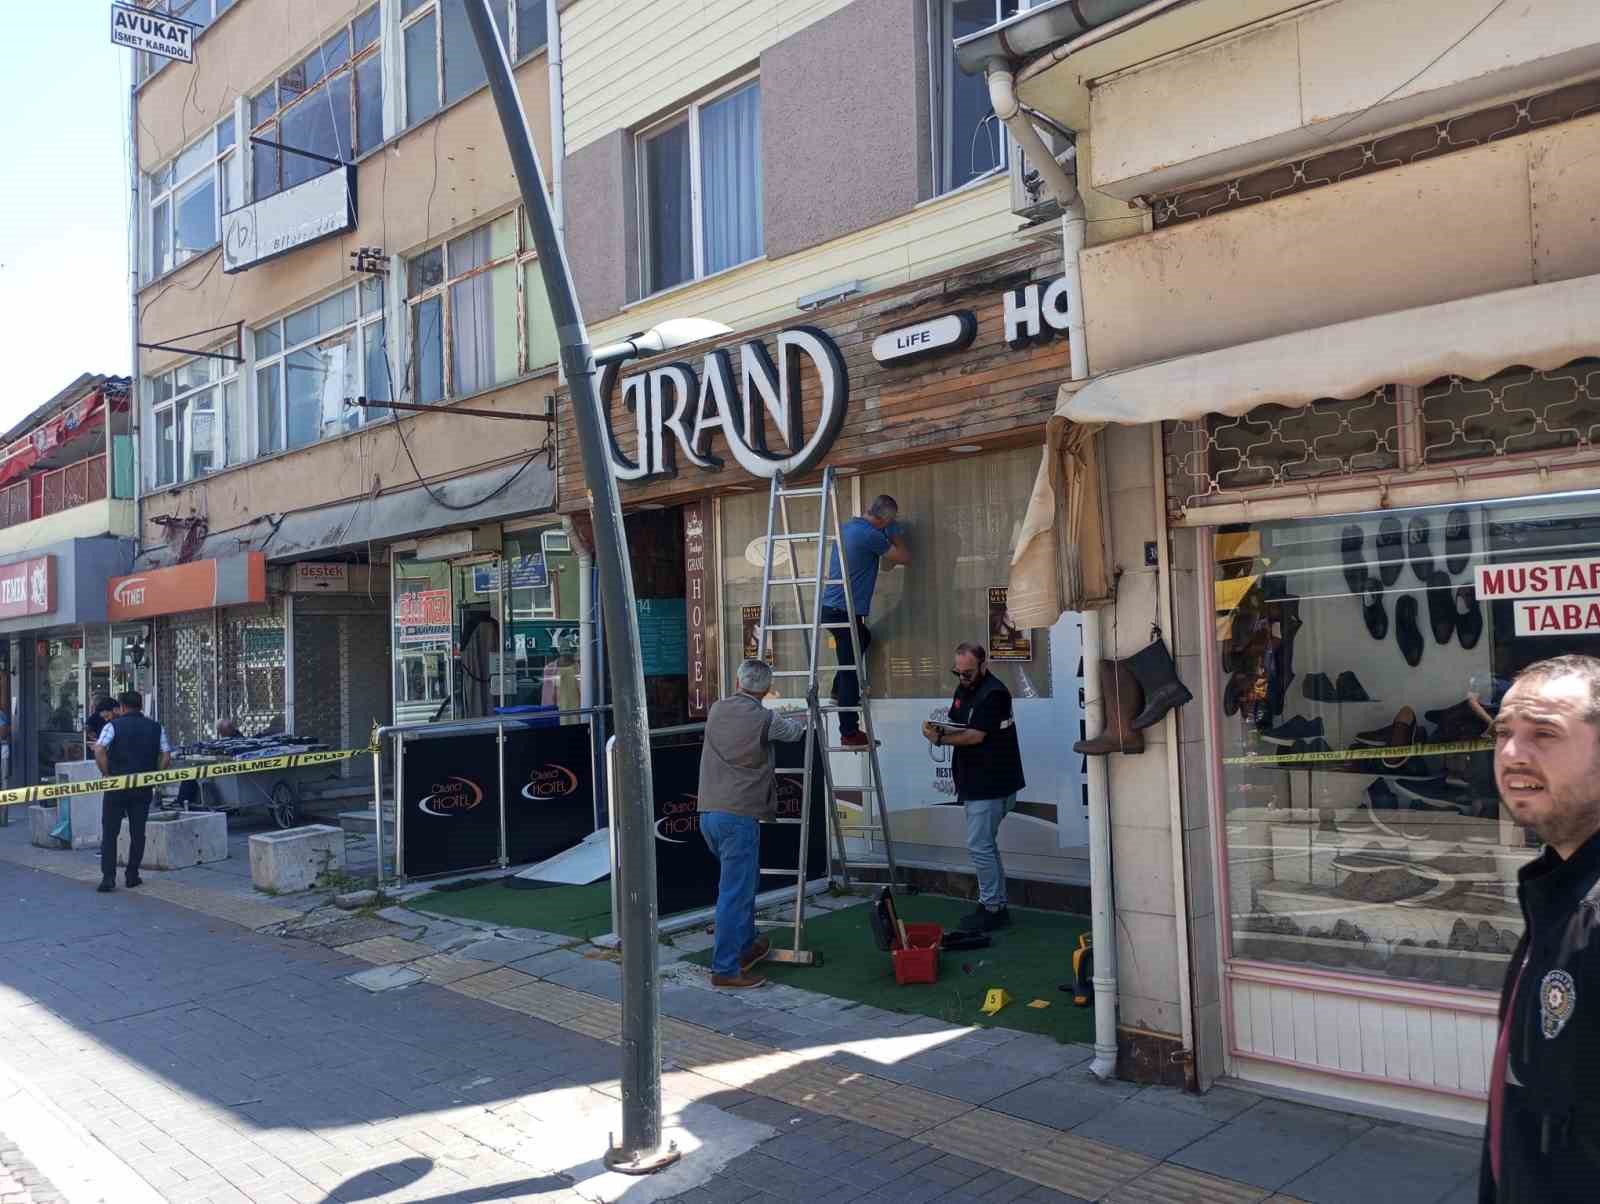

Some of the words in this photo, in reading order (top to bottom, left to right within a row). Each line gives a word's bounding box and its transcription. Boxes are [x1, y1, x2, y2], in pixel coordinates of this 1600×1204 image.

[115, 11, 188, 44] AVUKAT
[562, 330, 836, 479] GRAND
[692, 578, 703, 710] HOTEL
[1522, 603, 1600, 632] TABA
